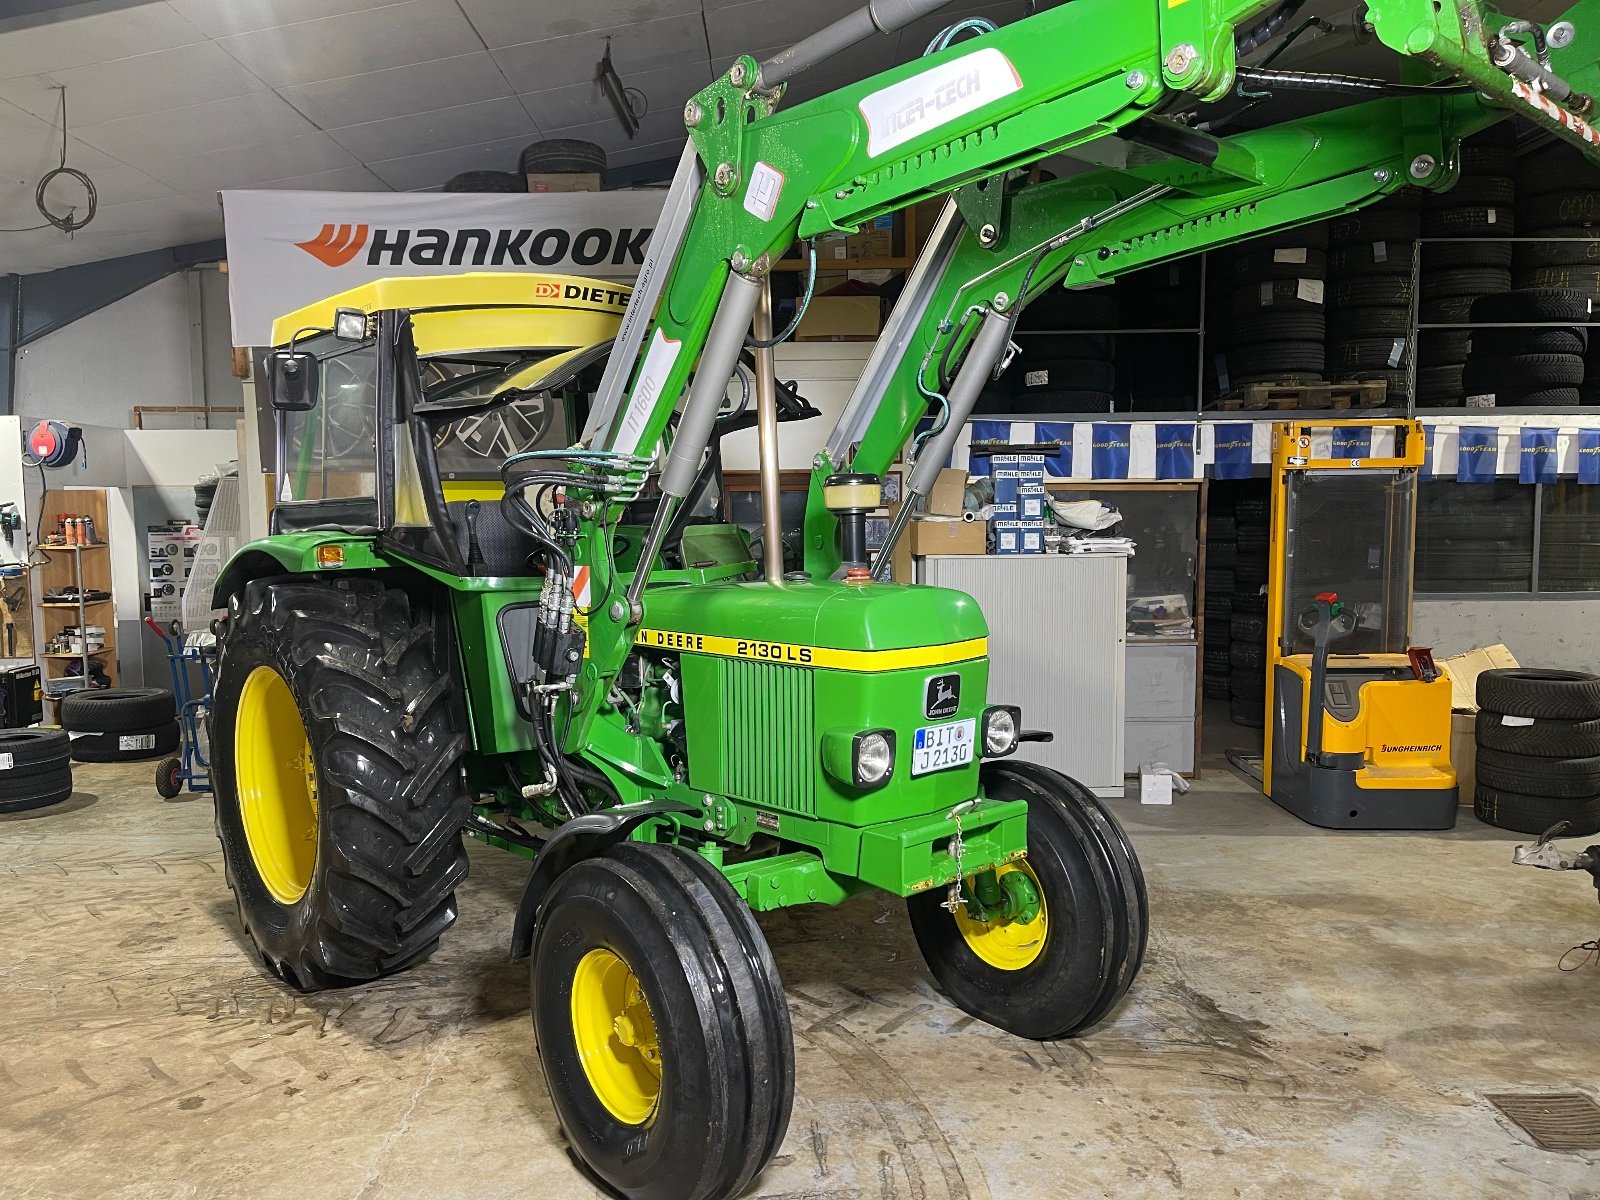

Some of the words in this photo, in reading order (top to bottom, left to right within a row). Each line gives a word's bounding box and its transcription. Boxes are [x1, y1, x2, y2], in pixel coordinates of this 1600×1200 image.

[634, 376, 656, 416] 1600
[657, 632, 703, 650] DEERE
[737, 641, 782, 658] 2130
[787, 647, 812, 663] LS
[943, 706, 957, 714] DEERE
[926, 726, 954, 749] BIT
[1381, 743, 1443, 753] JUNGHEINRICH
[920, 751, 930, 770] J
[933, 743, 967, 767] 2130
